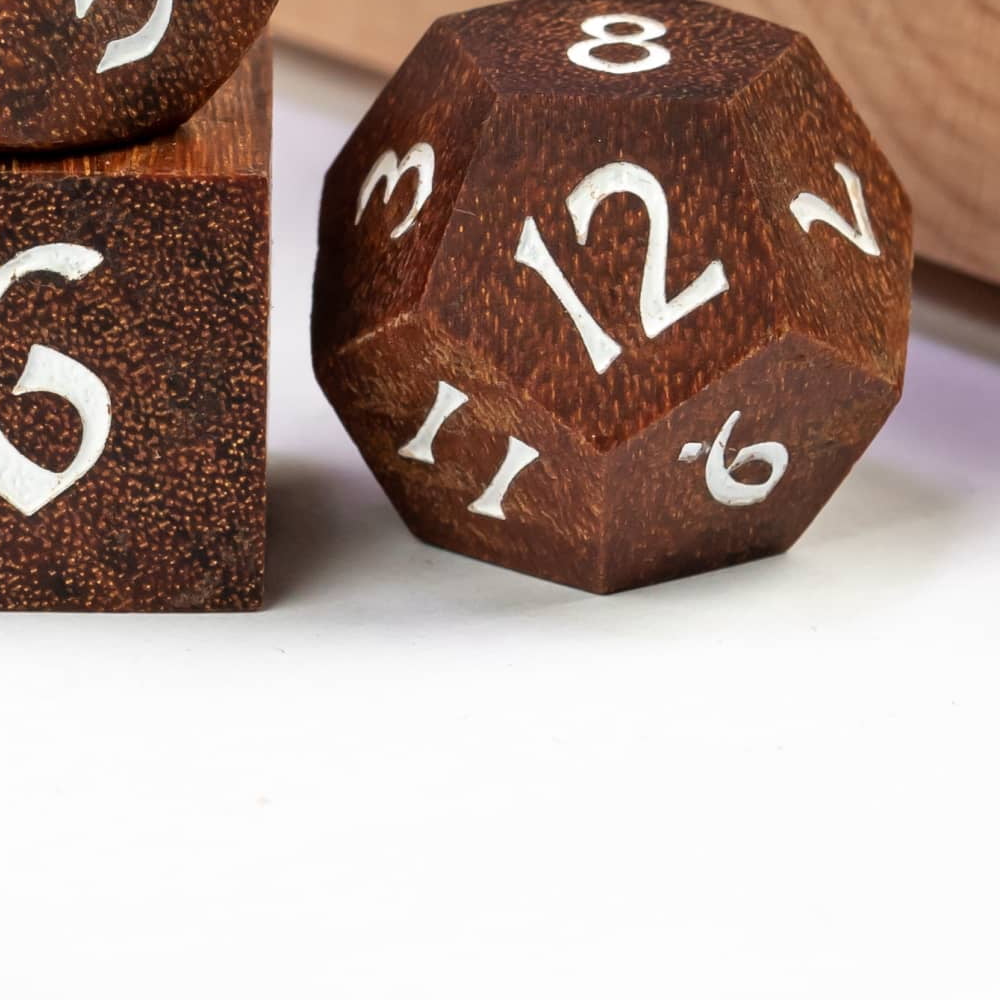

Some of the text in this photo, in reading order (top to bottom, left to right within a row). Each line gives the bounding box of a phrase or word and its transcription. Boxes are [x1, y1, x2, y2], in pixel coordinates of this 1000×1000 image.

[566, 11, 672, 75] 8
[354, 141, 437, 240] 3
[512, 160, 731, 376] 12
[397, 379, 541, 522] 11
